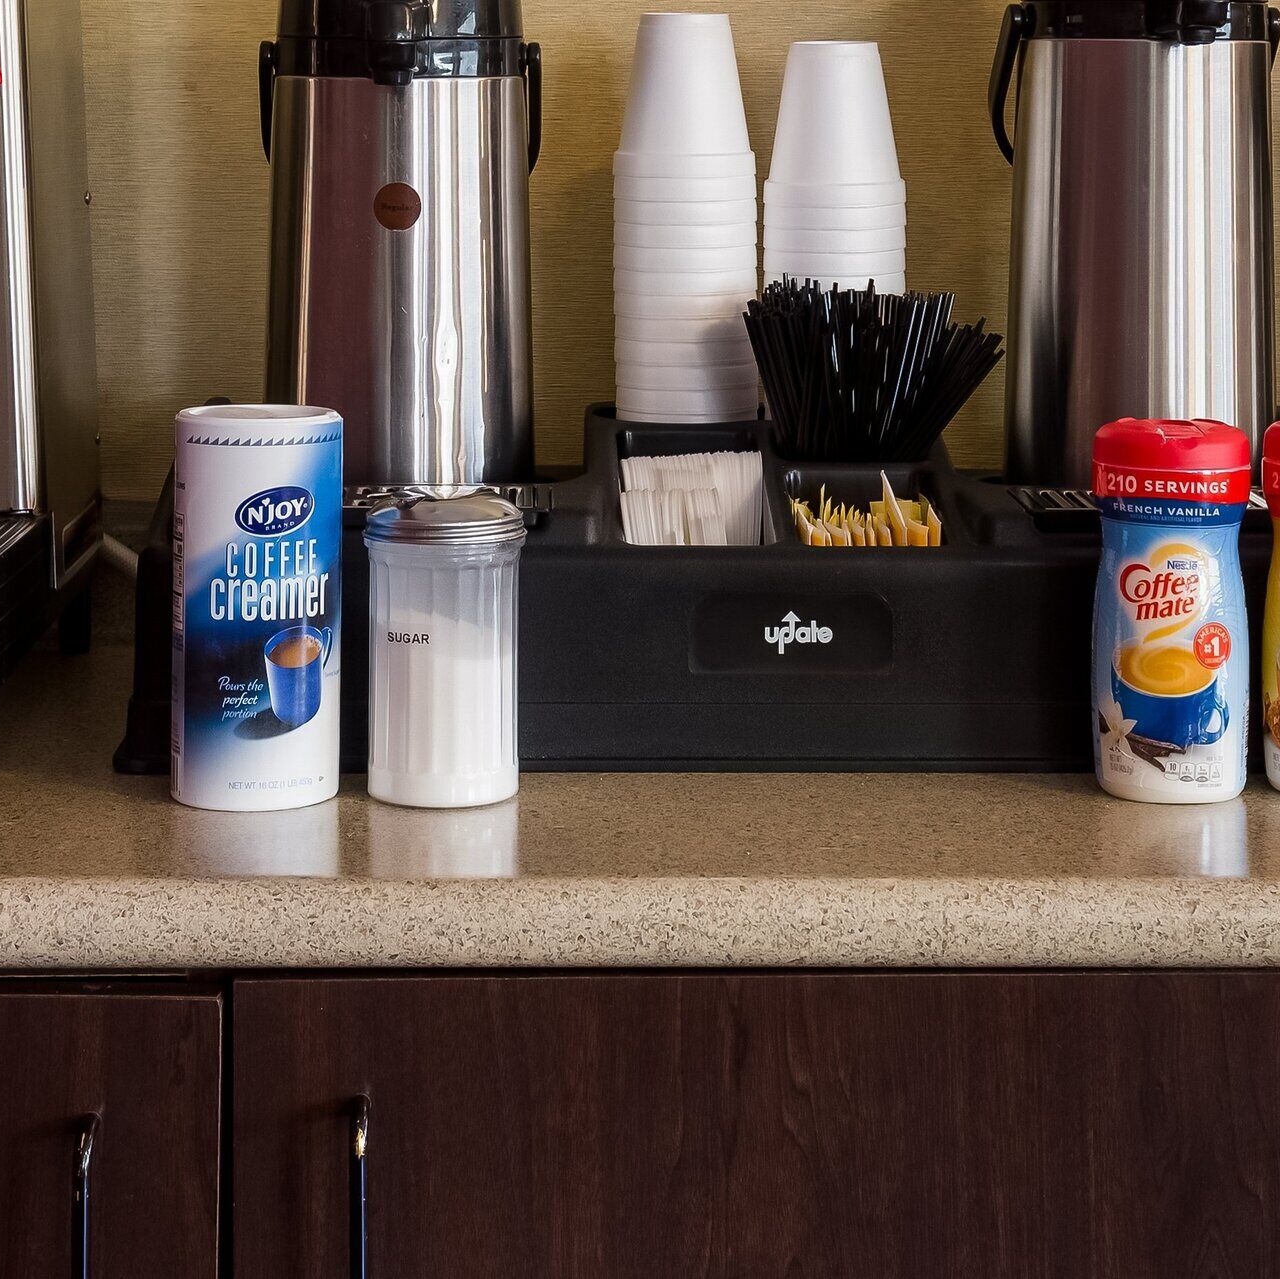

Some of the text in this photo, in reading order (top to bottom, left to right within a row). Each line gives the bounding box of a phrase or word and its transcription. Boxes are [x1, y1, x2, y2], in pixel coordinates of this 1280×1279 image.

[1107, 472, 1228, 494] 210 SERVINGS
[1113, 502, 1221, 517] FRENCH VANILLA
[265, 521, 295, 531] BRAND
[225, 538, 318, 578] COFFEE
[1119, 563, 1200, 603] Coffee
[210, 571, 329, 621] creamer
[1135, 596, 1195, 621] mate
[387, 631, 431, 645] SUGAR
[764, 611, 834, 655] update
[1203, 636, 1220, 657] #1
[217, 675, 264, 692] Pours the
[222, 692, 259, 708] perfect
[221, 707, 258, 722] portion
[1169, 763, 1177, 771] 10
[228, 781, 242, 790] NET
[244, 781, 257, 790] WT
[259, 781, 267, 789] 16
